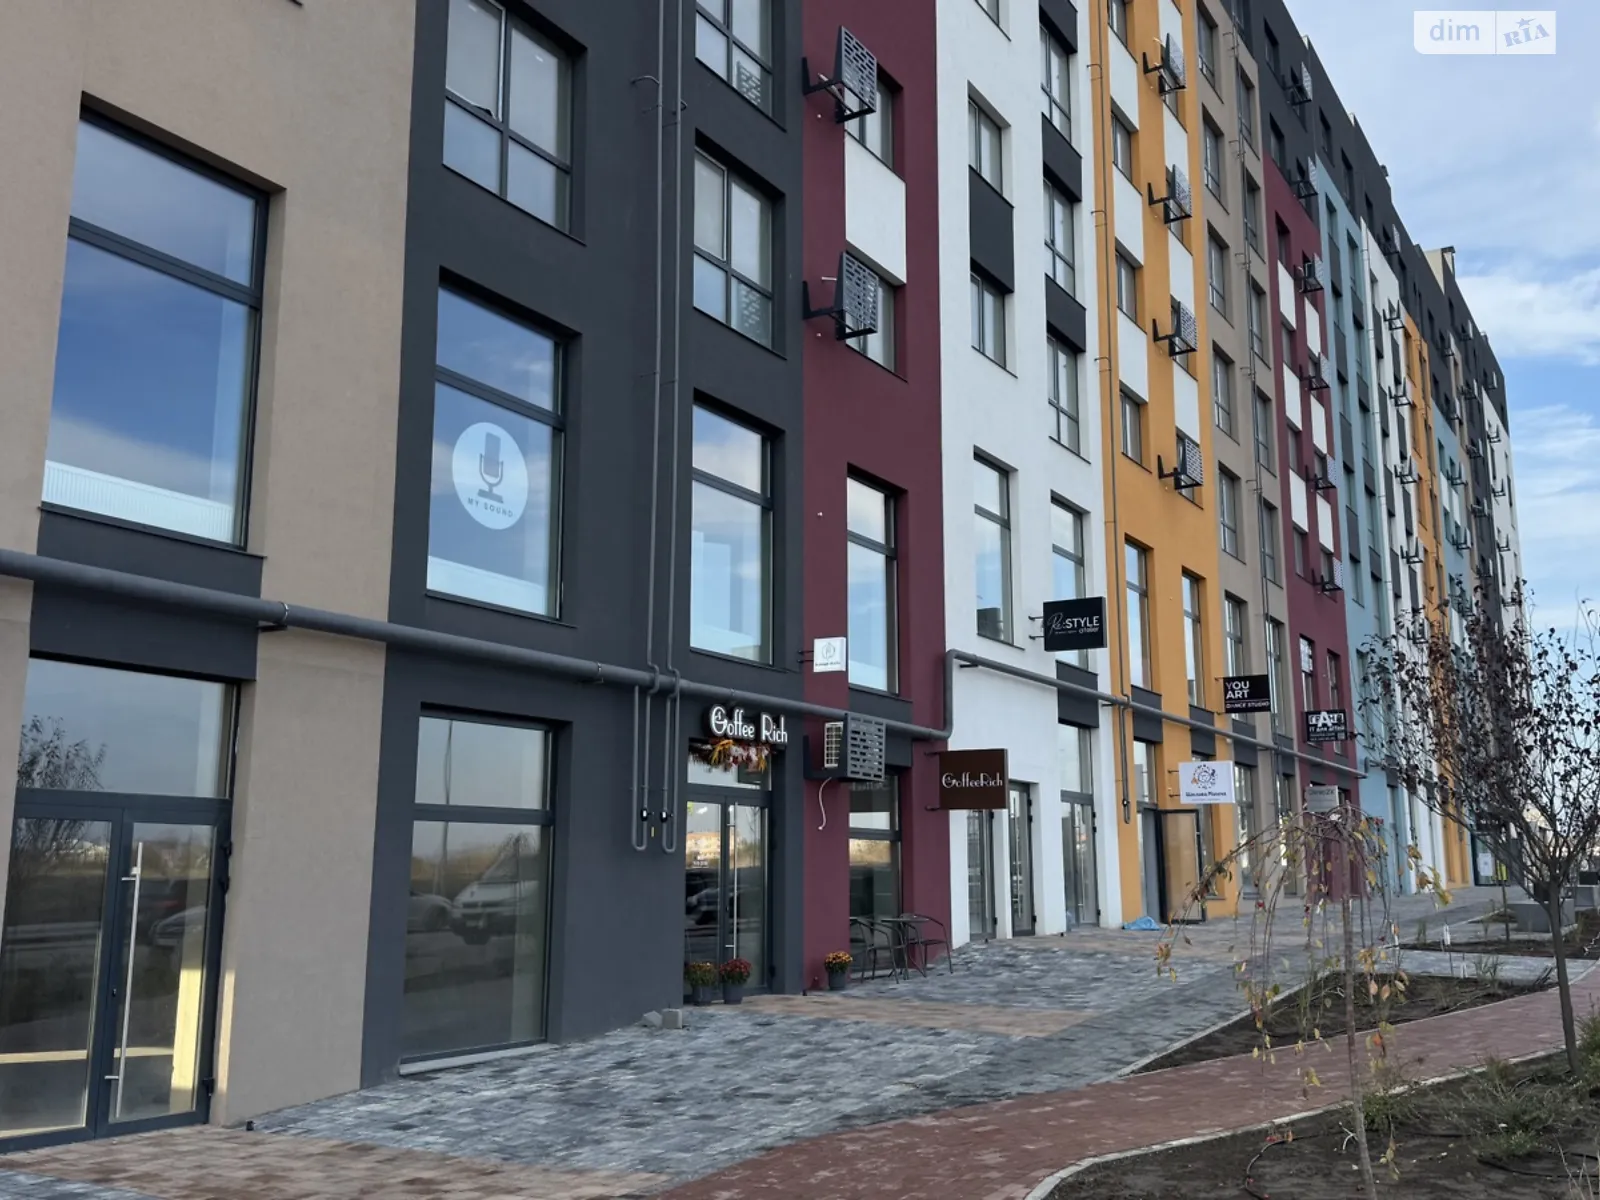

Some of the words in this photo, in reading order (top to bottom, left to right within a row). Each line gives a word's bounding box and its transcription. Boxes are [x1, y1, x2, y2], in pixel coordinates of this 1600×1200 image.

[467, 497, 479, 507] MY
[484, 502, 513, 518] SOUND
[1226, 681, 1250, 690] YOU
[1226, 689, 1249, 699] ART
[761, 713, 788, 743] Rich
